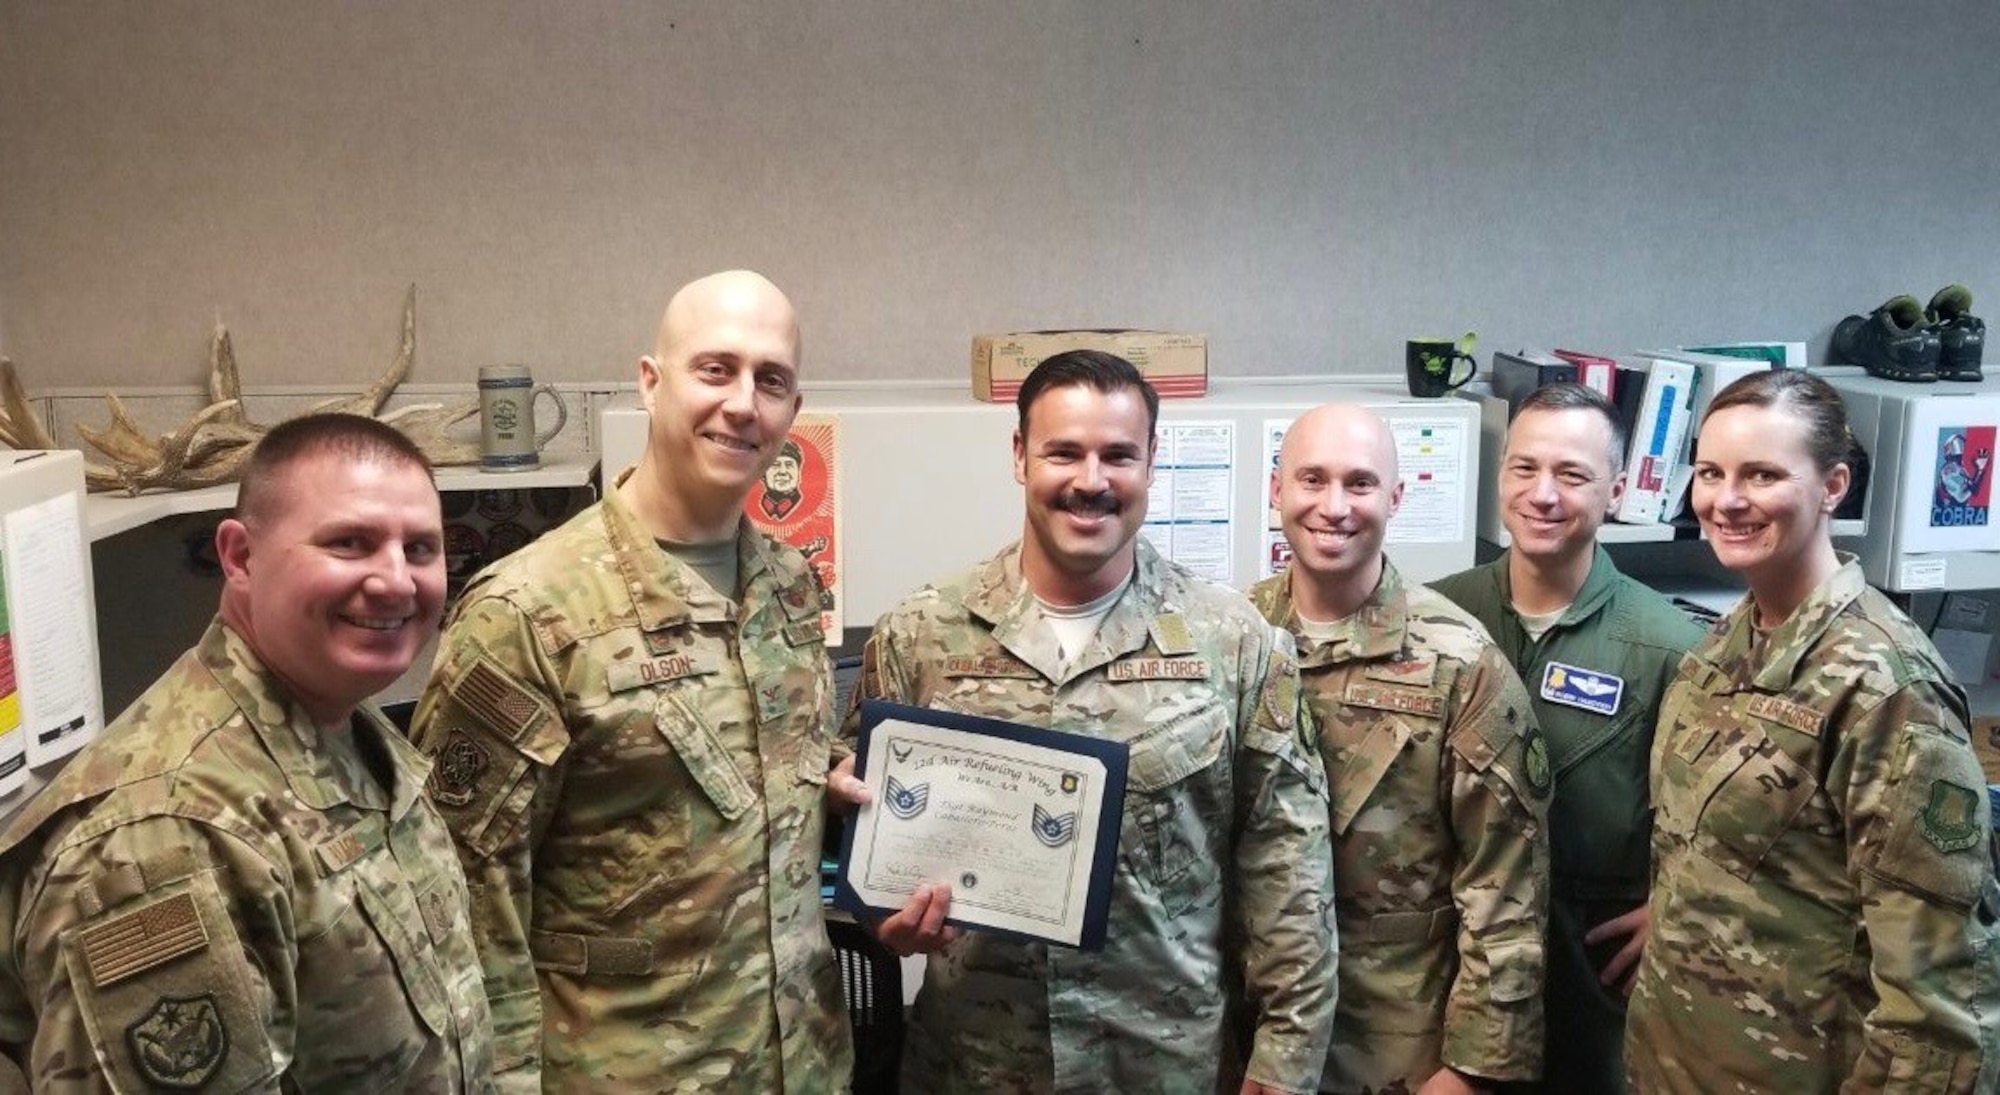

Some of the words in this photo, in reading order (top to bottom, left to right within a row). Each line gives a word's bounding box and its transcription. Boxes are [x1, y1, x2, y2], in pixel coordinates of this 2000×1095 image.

[1931, 507, 1987, 526] COBRA
[640, 655, 691, 681] OLSON
[1139, 661, 1160, 676] AIR
[1164, 660, 1204, 677] FORCE
[1784, 705, 1818, 732] FORCE
[941, 755, 960, 766] Air
[964, 758, 1022, 781] Refueling
[1028, 772, 1057, 796] Wing
